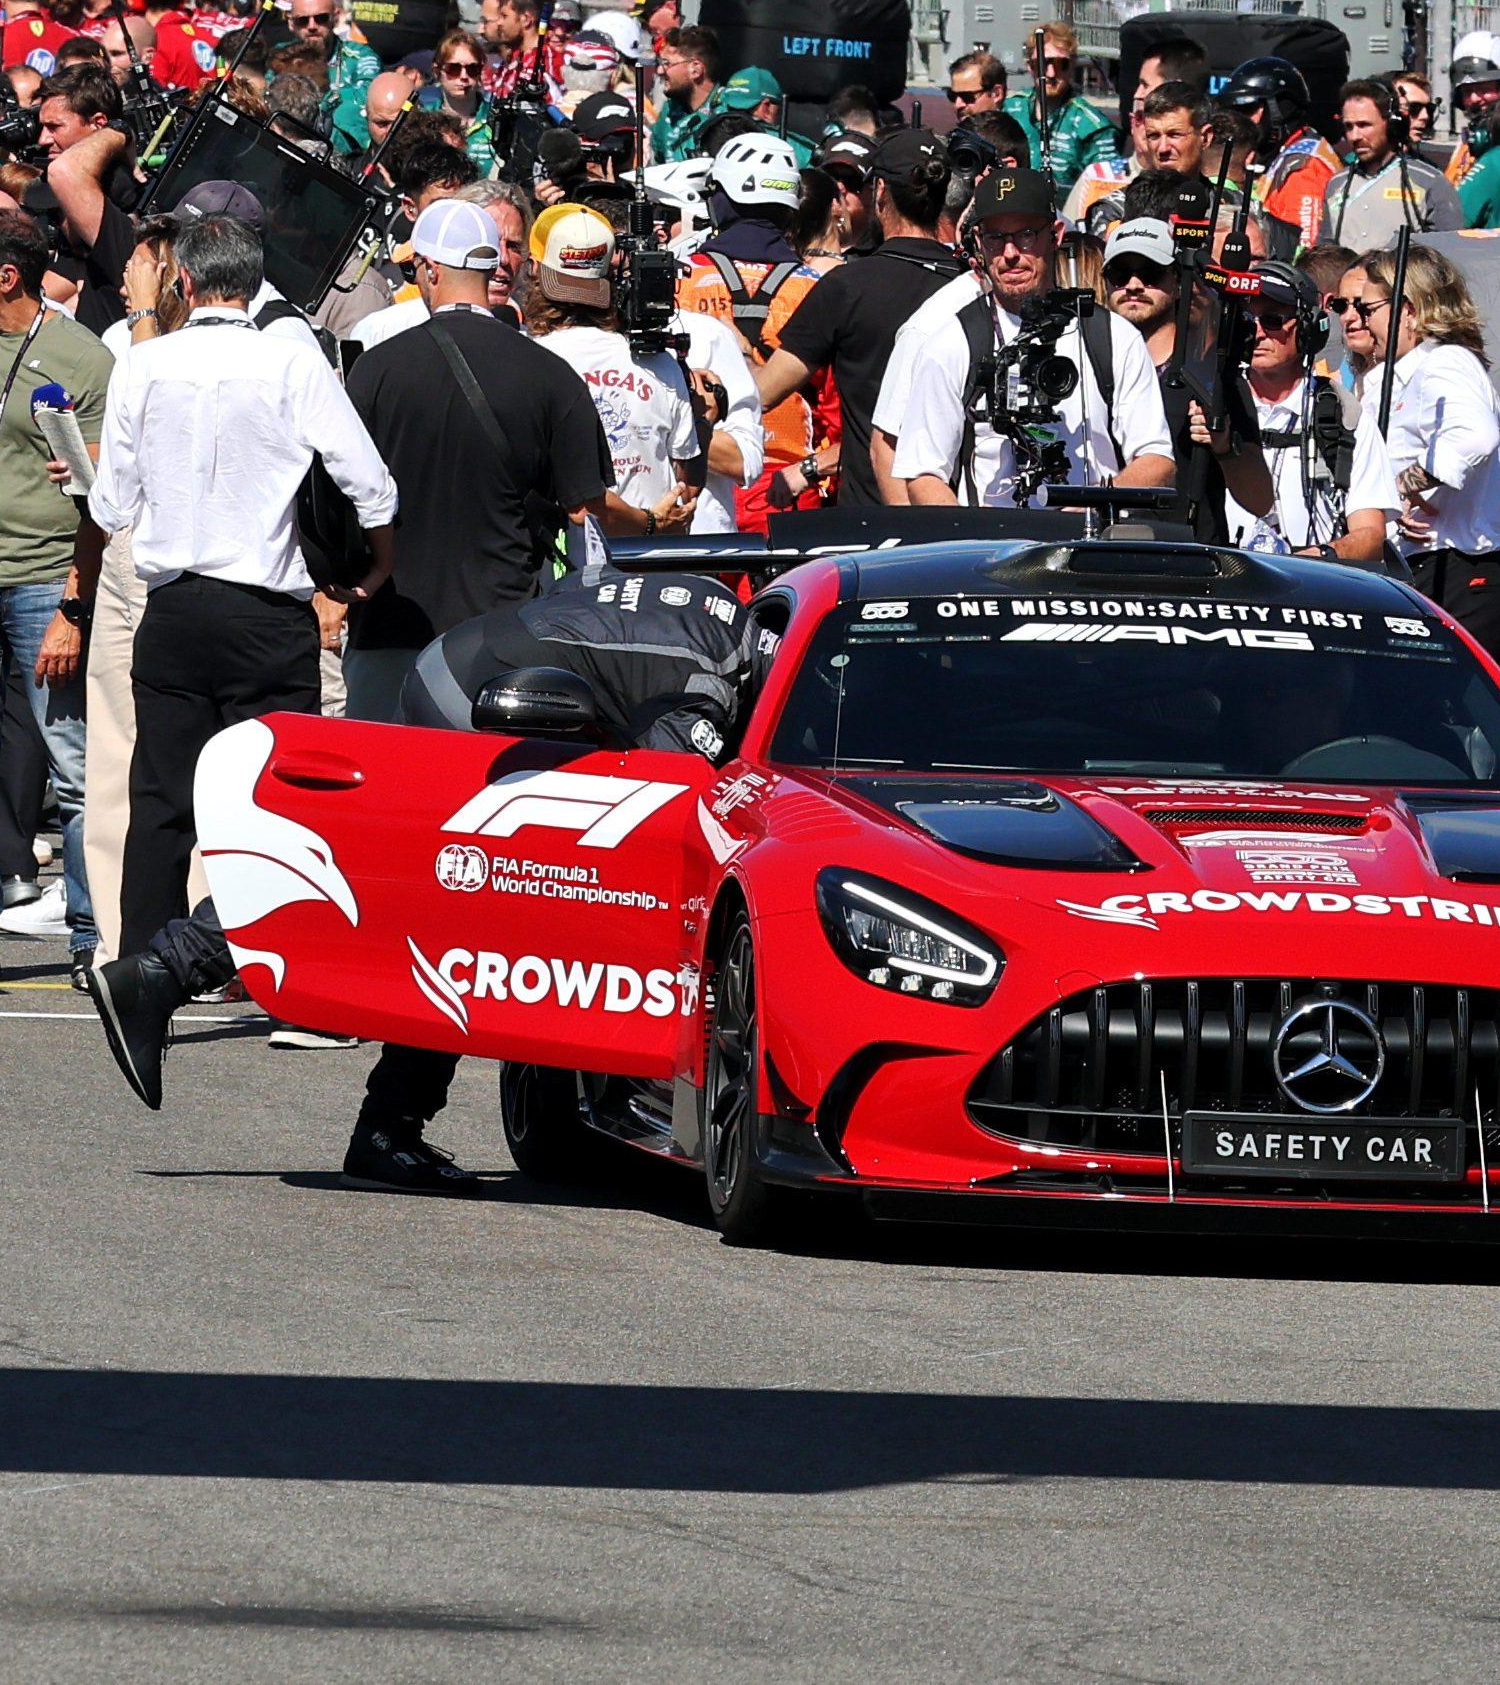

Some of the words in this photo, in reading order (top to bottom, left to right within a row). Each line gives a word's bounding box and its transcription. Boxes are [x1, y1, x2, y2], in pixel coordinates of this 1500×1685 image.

[782, 34, 818, 59] LEFT
[825, 37, 872, 60] FRONT
[1178, 193, 1197, 203] ORF
[1224, 243, 1244, 253] ORF
[1229, 275, 1262, 291] ORF
[582, 368, 654, 402] NGA'S
[619, 577, 645, 613] SAFETY
[937, 600, 1001, 618] ONE
[1282, 606, 1364, 630] FIRST
[1102, 624, 1315, 651] AMG
[492, 856, 519, 875] FIA
[522, 859, 589, 882] Formula
[589, 867, 599, 884] 1
[492, 875, 540, 896] World
[542, 880, 657, 911] Championship
[1216, 1131, 1350, 1161] SAFETY
[1366, 1137, 1433, 1165] CAR
